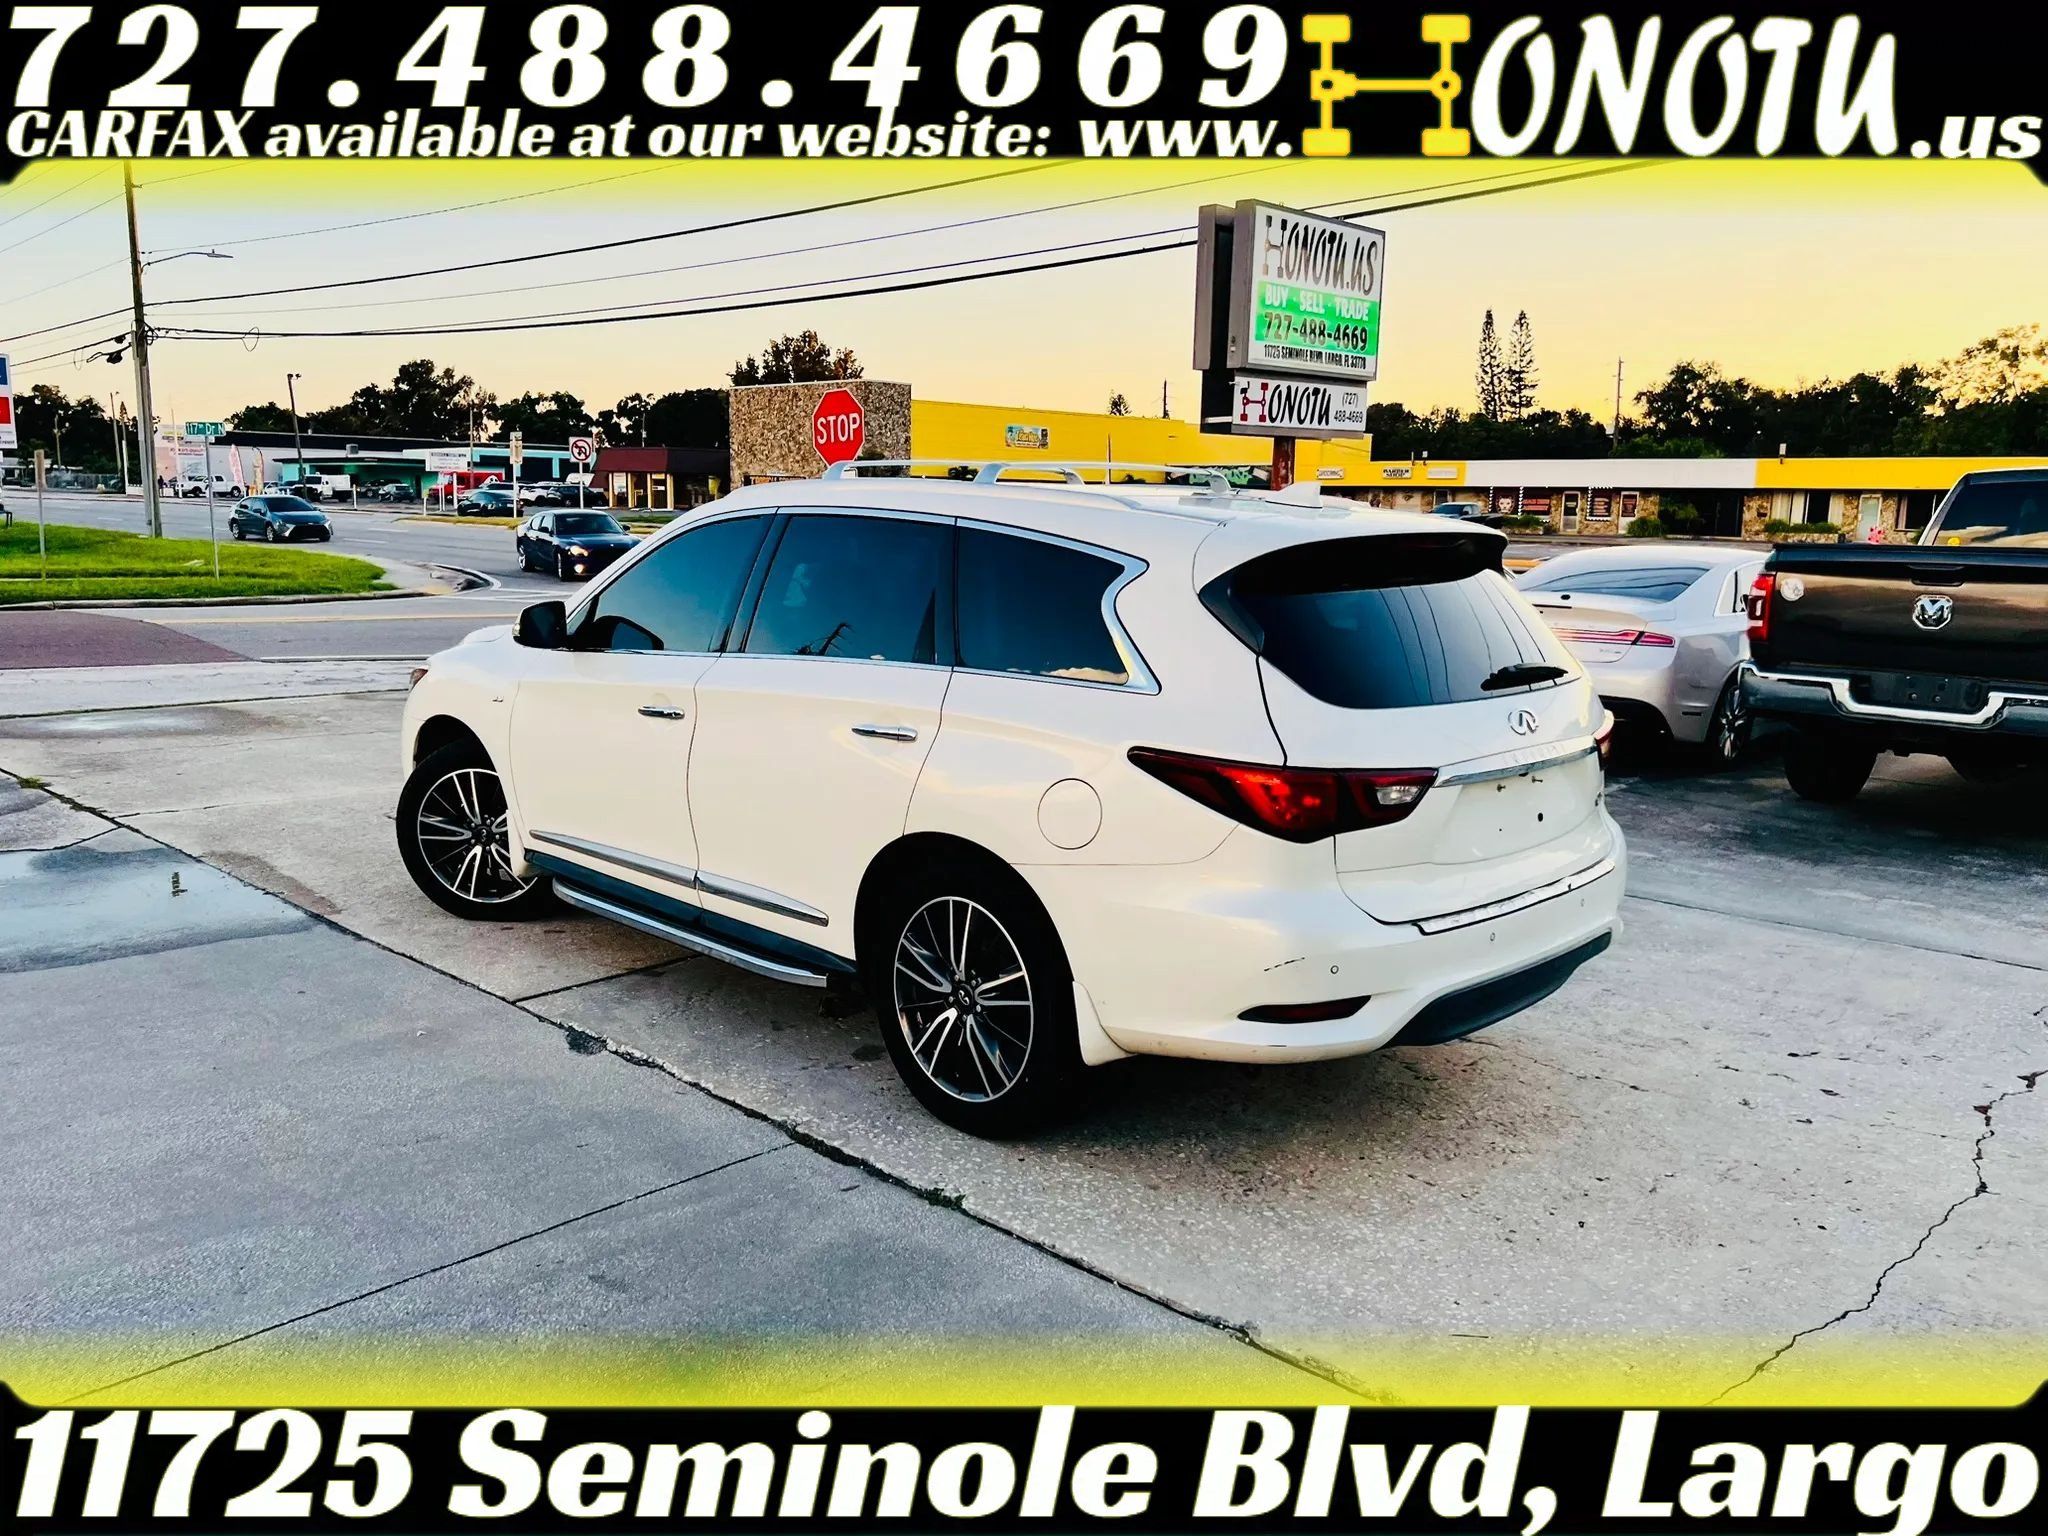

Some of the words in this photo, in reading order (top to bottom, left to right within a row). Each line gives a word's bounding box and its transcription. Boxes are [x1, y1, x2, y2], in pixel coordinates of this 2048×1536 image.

[1265, 284, 1289, 308] BUY
[1299, 290, 1325, 314] SELL
[1335, 297, 1369, 321] TRADE
[1264, 311, 1368, 352] 727-488-4669
[1264, 344, 1281, 359] 11725
[1281, 346, 1309, 362] SEMINOLE
[1344, 355, 1350, 367] FL
[1341, 391, 1359, 408] (727)
[816, 412, 860, 444] STOP
[1334, 410, 1363, 424] 488-4669
[205, 423, 215, 435] Dr
[218, 423, 225, 436] N
